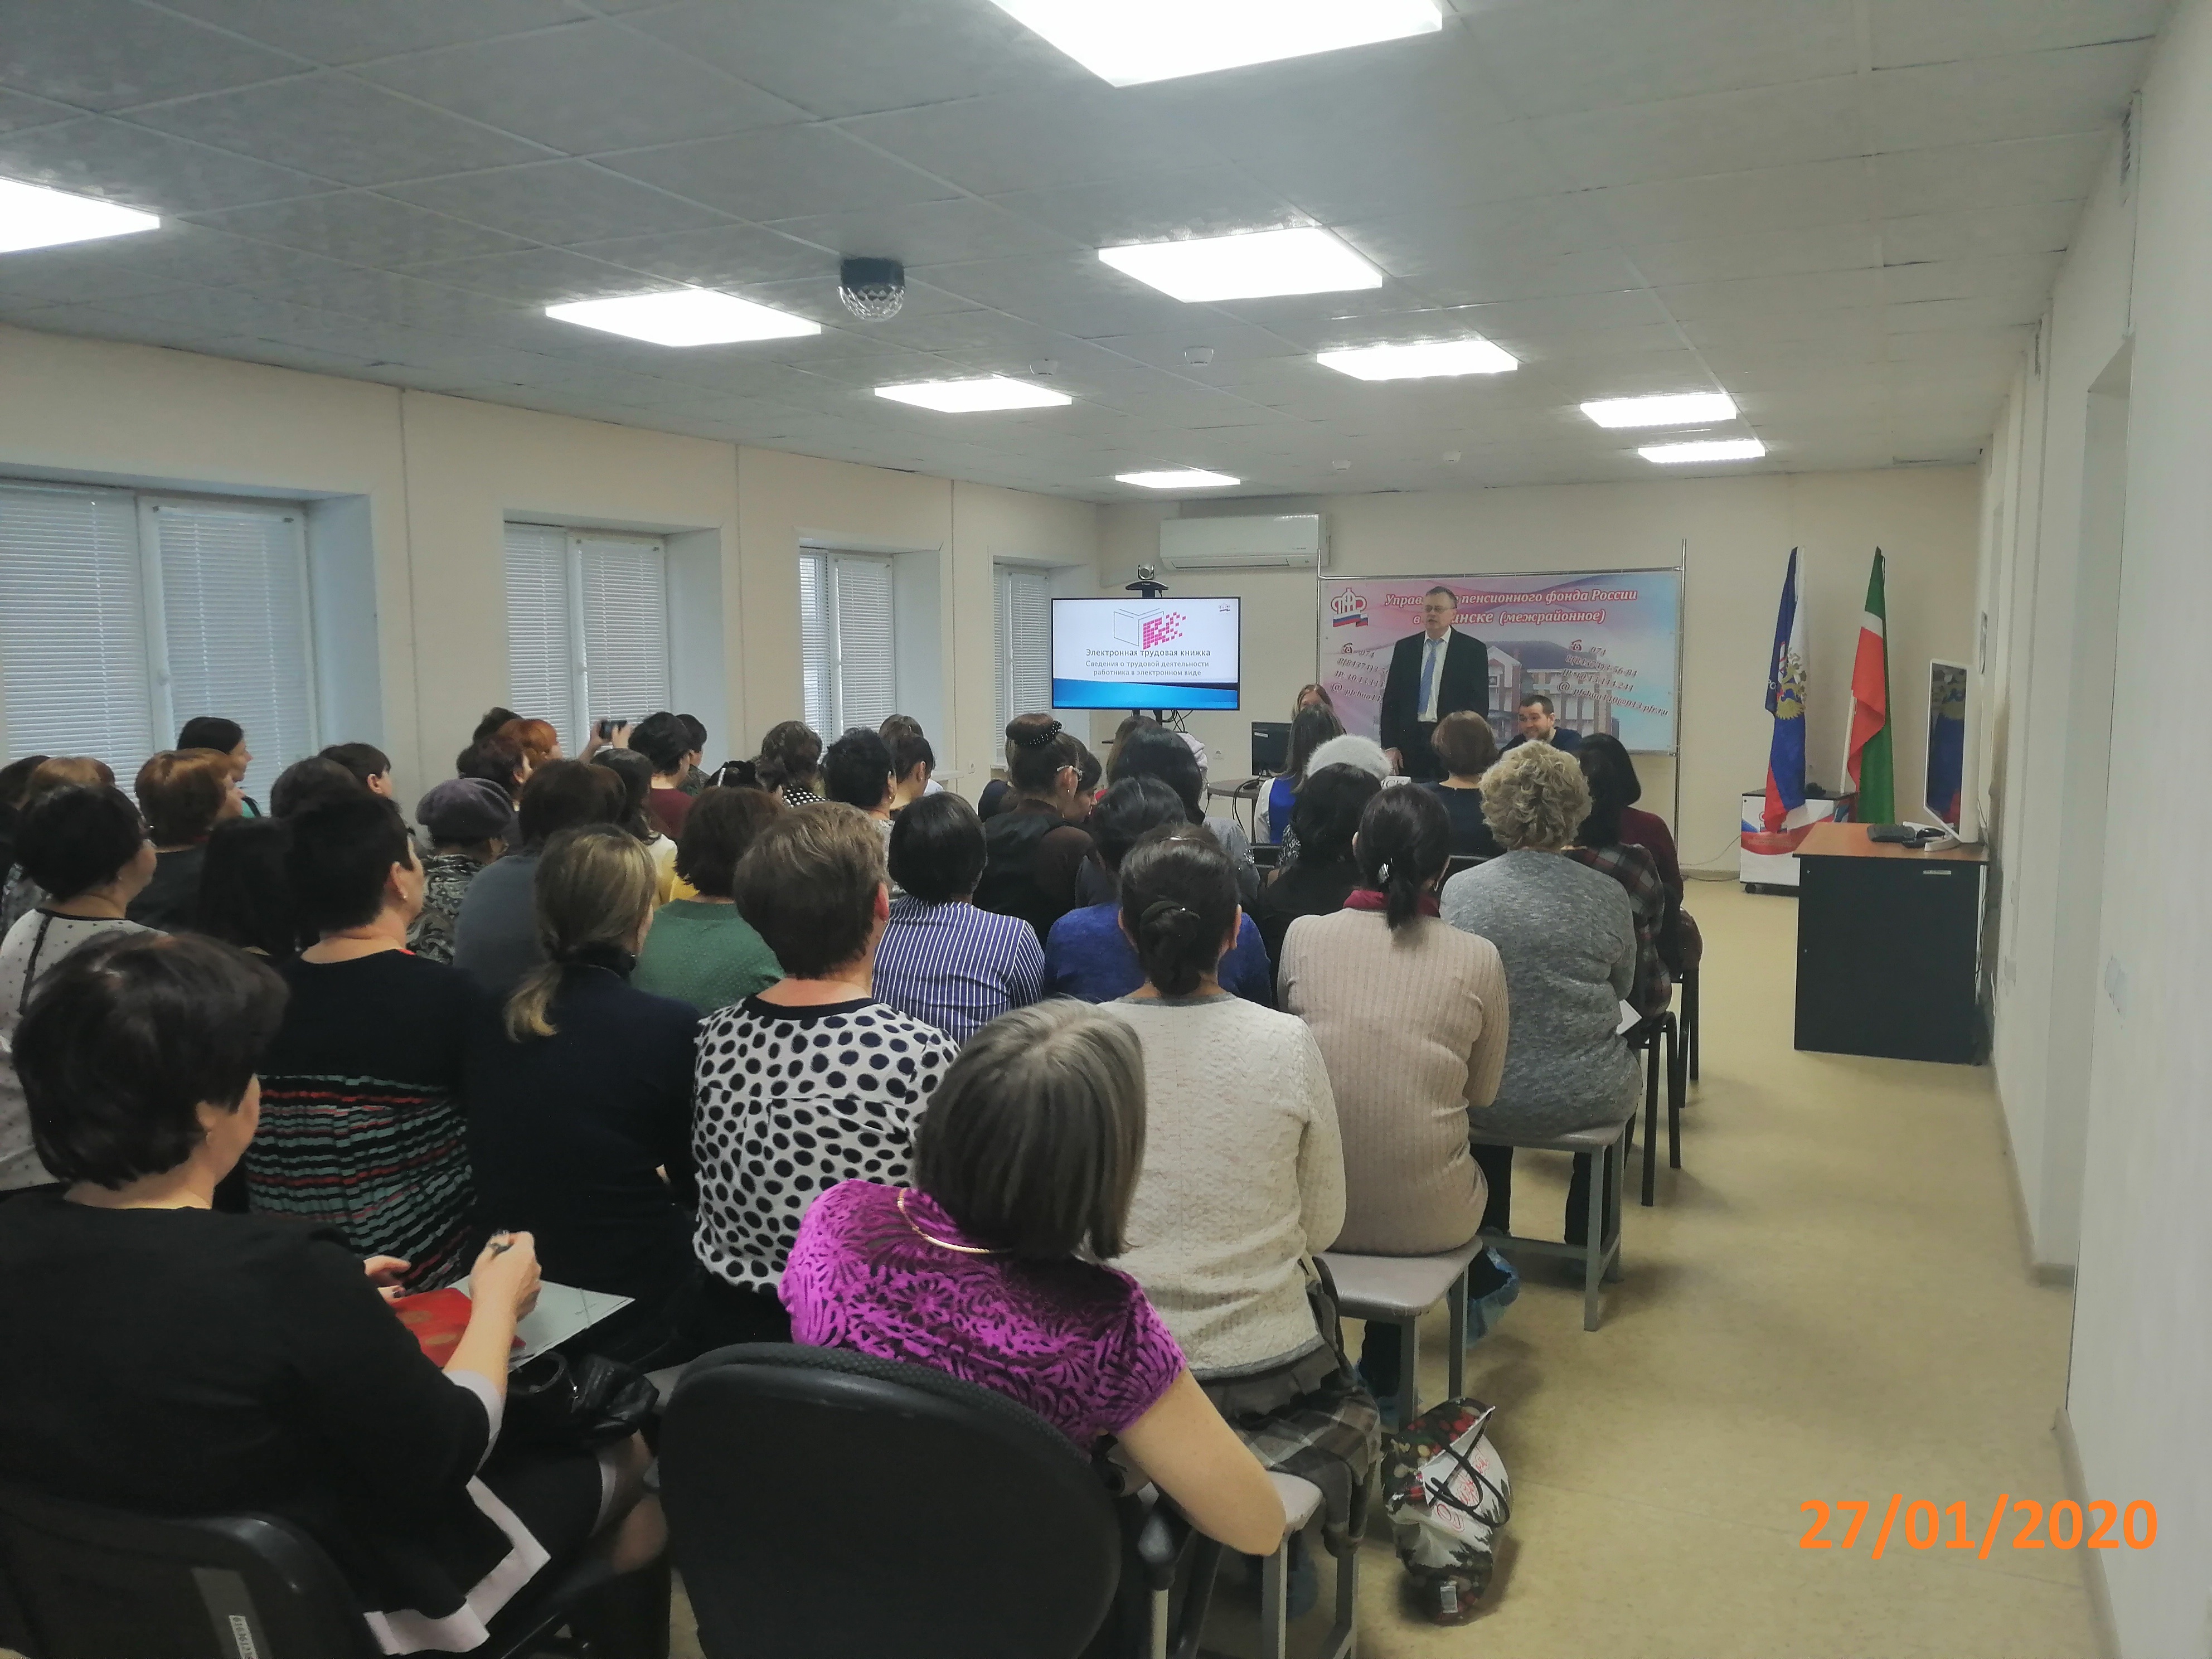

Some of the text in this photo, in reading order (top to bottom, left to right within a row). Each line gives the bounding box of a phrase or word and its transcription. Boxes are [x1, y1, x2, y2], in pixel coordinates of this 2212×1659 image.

[1461, 593, 1543, 604] пенсионного
[1545, 589, 1588, 605] фонда
[1591, 589, 1638, 601] России
[1413, 609, 1606, 626] в инске (межрайонное)
[1086, 649, 1138, 657] Электронная
